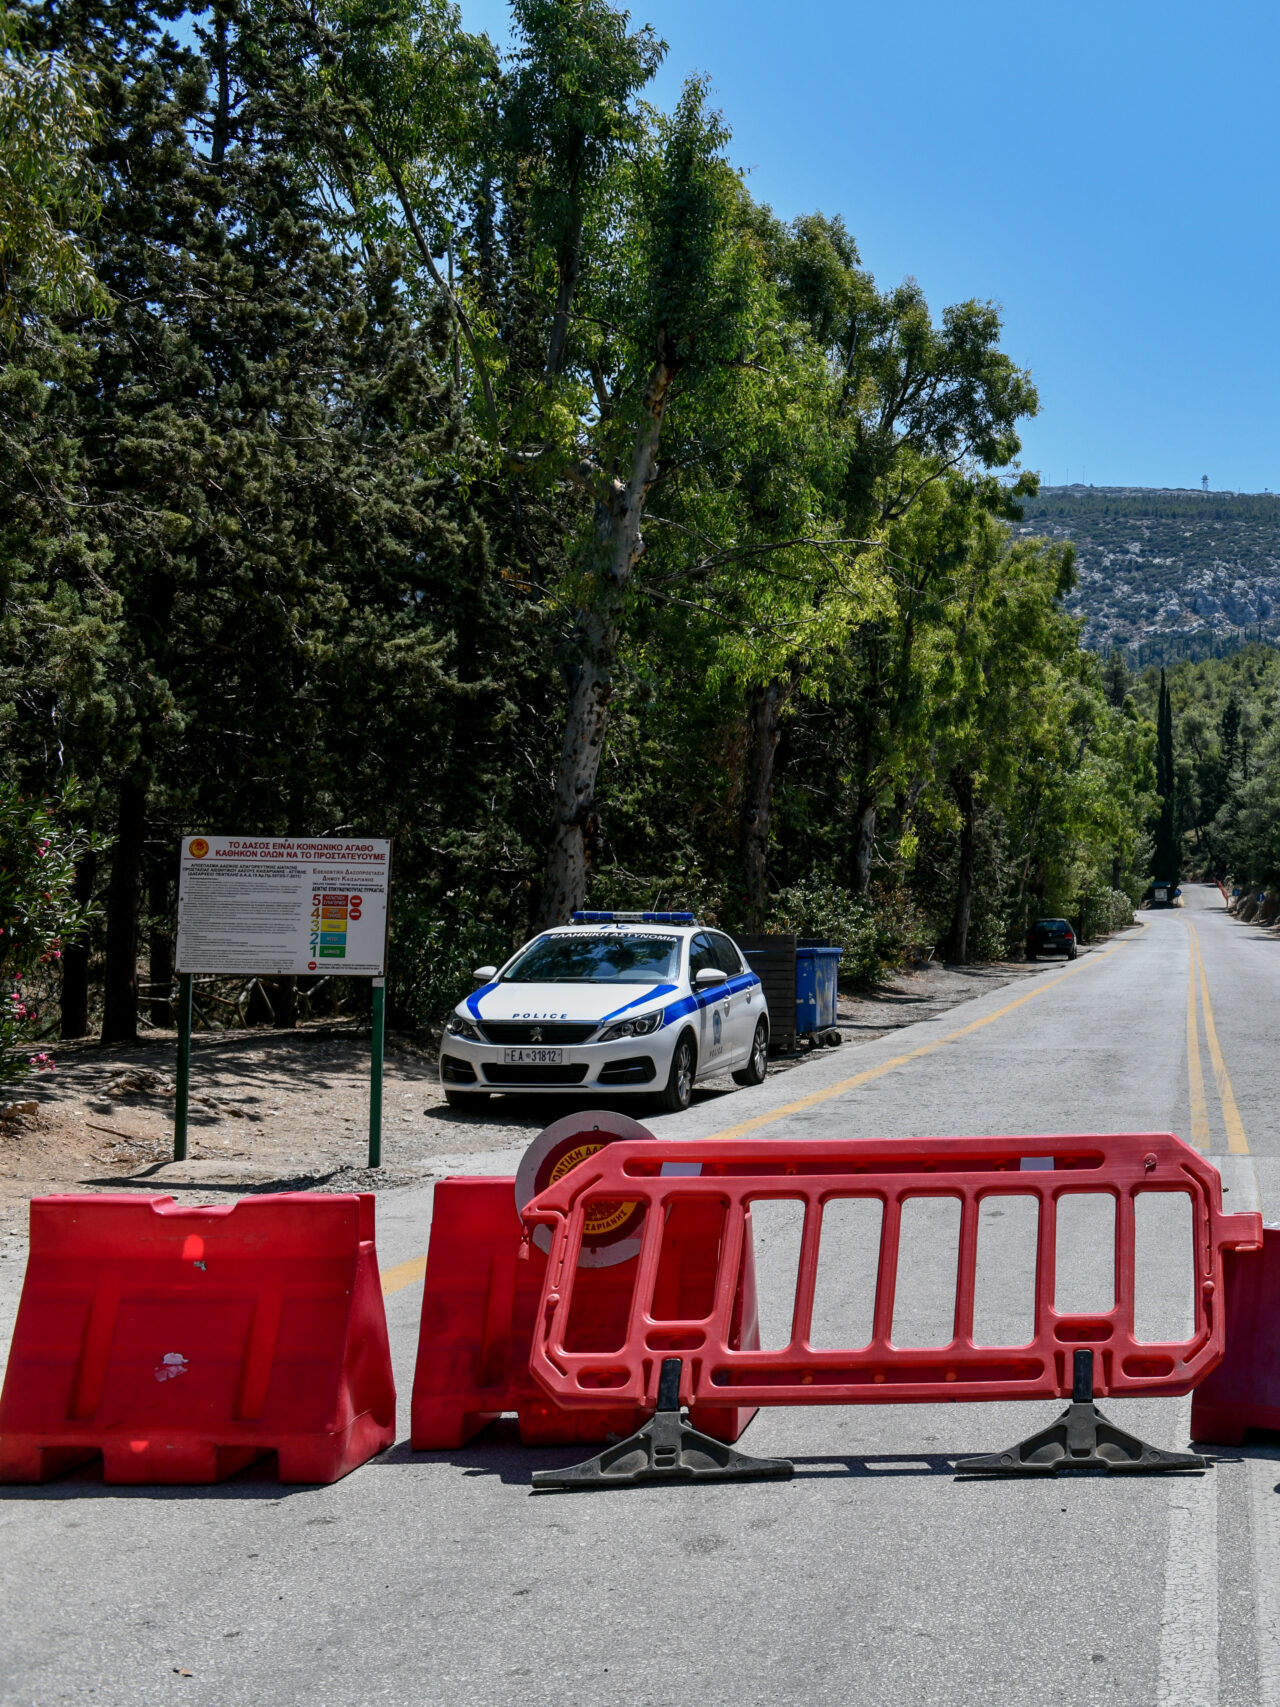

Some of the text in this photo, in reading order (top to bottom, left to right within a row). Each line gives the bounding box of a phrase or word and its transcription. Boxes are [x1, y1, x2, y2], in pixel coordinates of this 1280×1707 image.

[297, 843, 343, 851] ΚΟΙΝΩΝΙΚΟ
[216, 850, 257, 858] ΚΑΘΗΚΟΝ
[259, 850, 284, 858] ΟΛΩΝ
[314, 852, 386, 861] ΠΡΟΣΤΑΤΕΥΟΥΜΕ
[312, 894, 321, 906] 5
[311, 907, 320, 919] 4
[310, 920, 319, 932] 3
[309, 932, 319, 945] 2
[550, 931, 678, 942] ΕΛΛΗΝΙΚΗ ΑΣΤΥΝΟΜΙΑ
[310, 945, 317, 957] 1
[512, 1012, 568, 1020] POLICE
[531, 1050, 556, 1062] 31812
[552, 1149, 583, 1182] ΟΝΤΙΚΗ
[584, 1209, 628, 1231] ΣΑΡΙΑΝΗΣ
